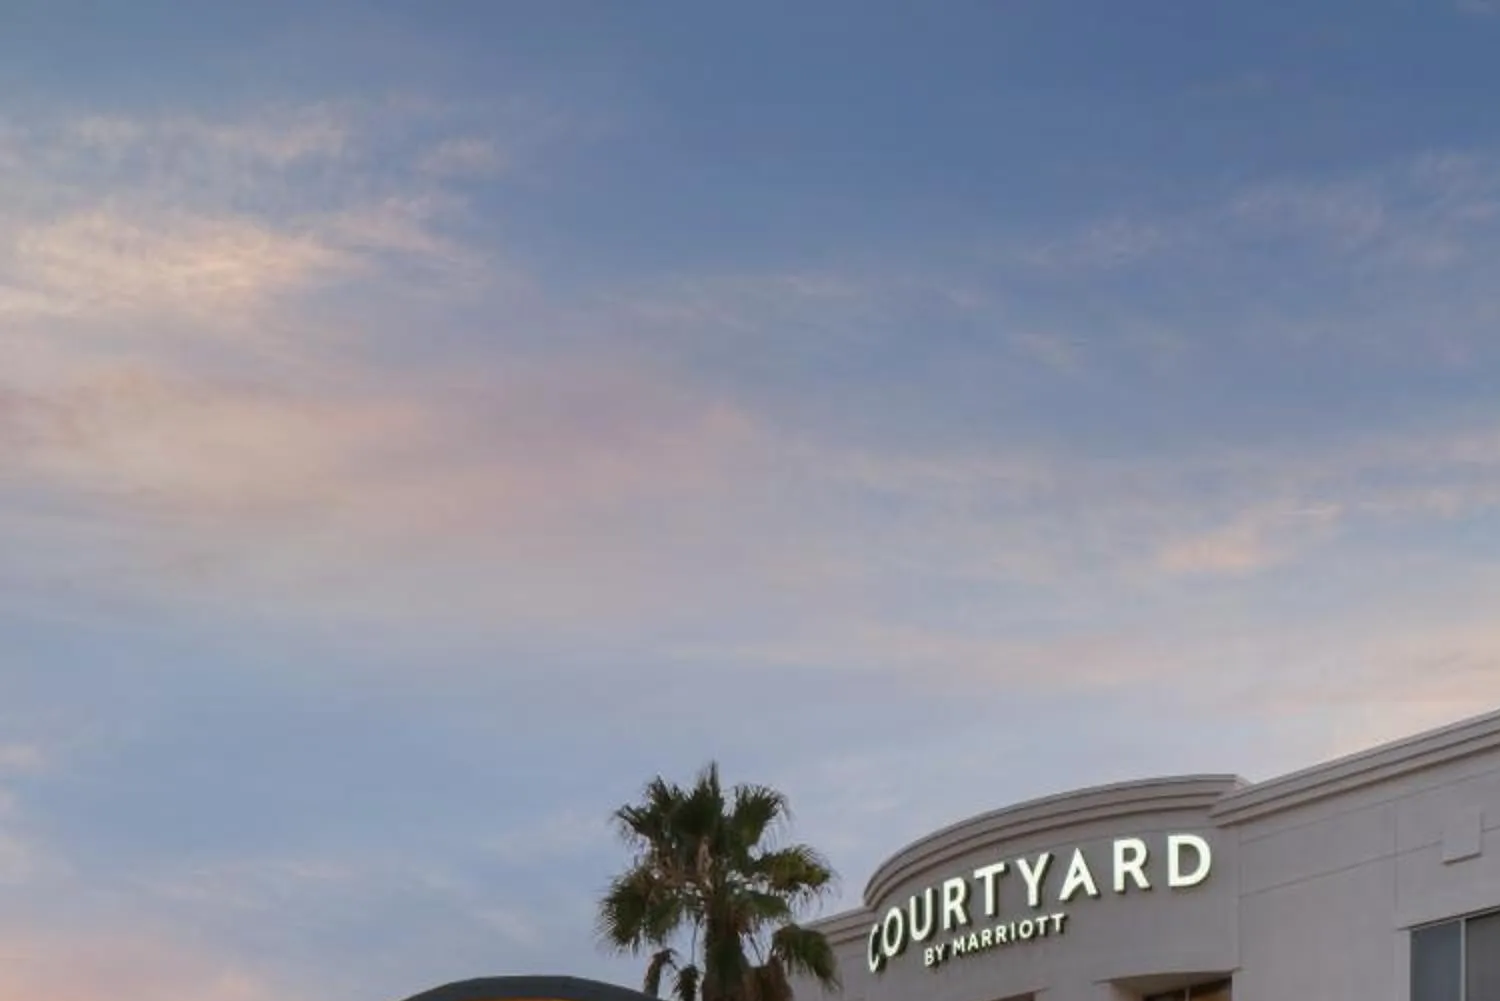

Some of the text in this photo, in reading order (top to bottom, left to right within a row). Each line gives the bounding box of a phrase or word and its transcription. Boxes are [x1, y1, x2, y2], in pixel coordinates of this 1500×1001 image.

[867, 833, 1213, 973] COURTYARD
[924, 912, 1066, 967] BY MARRIOTT
